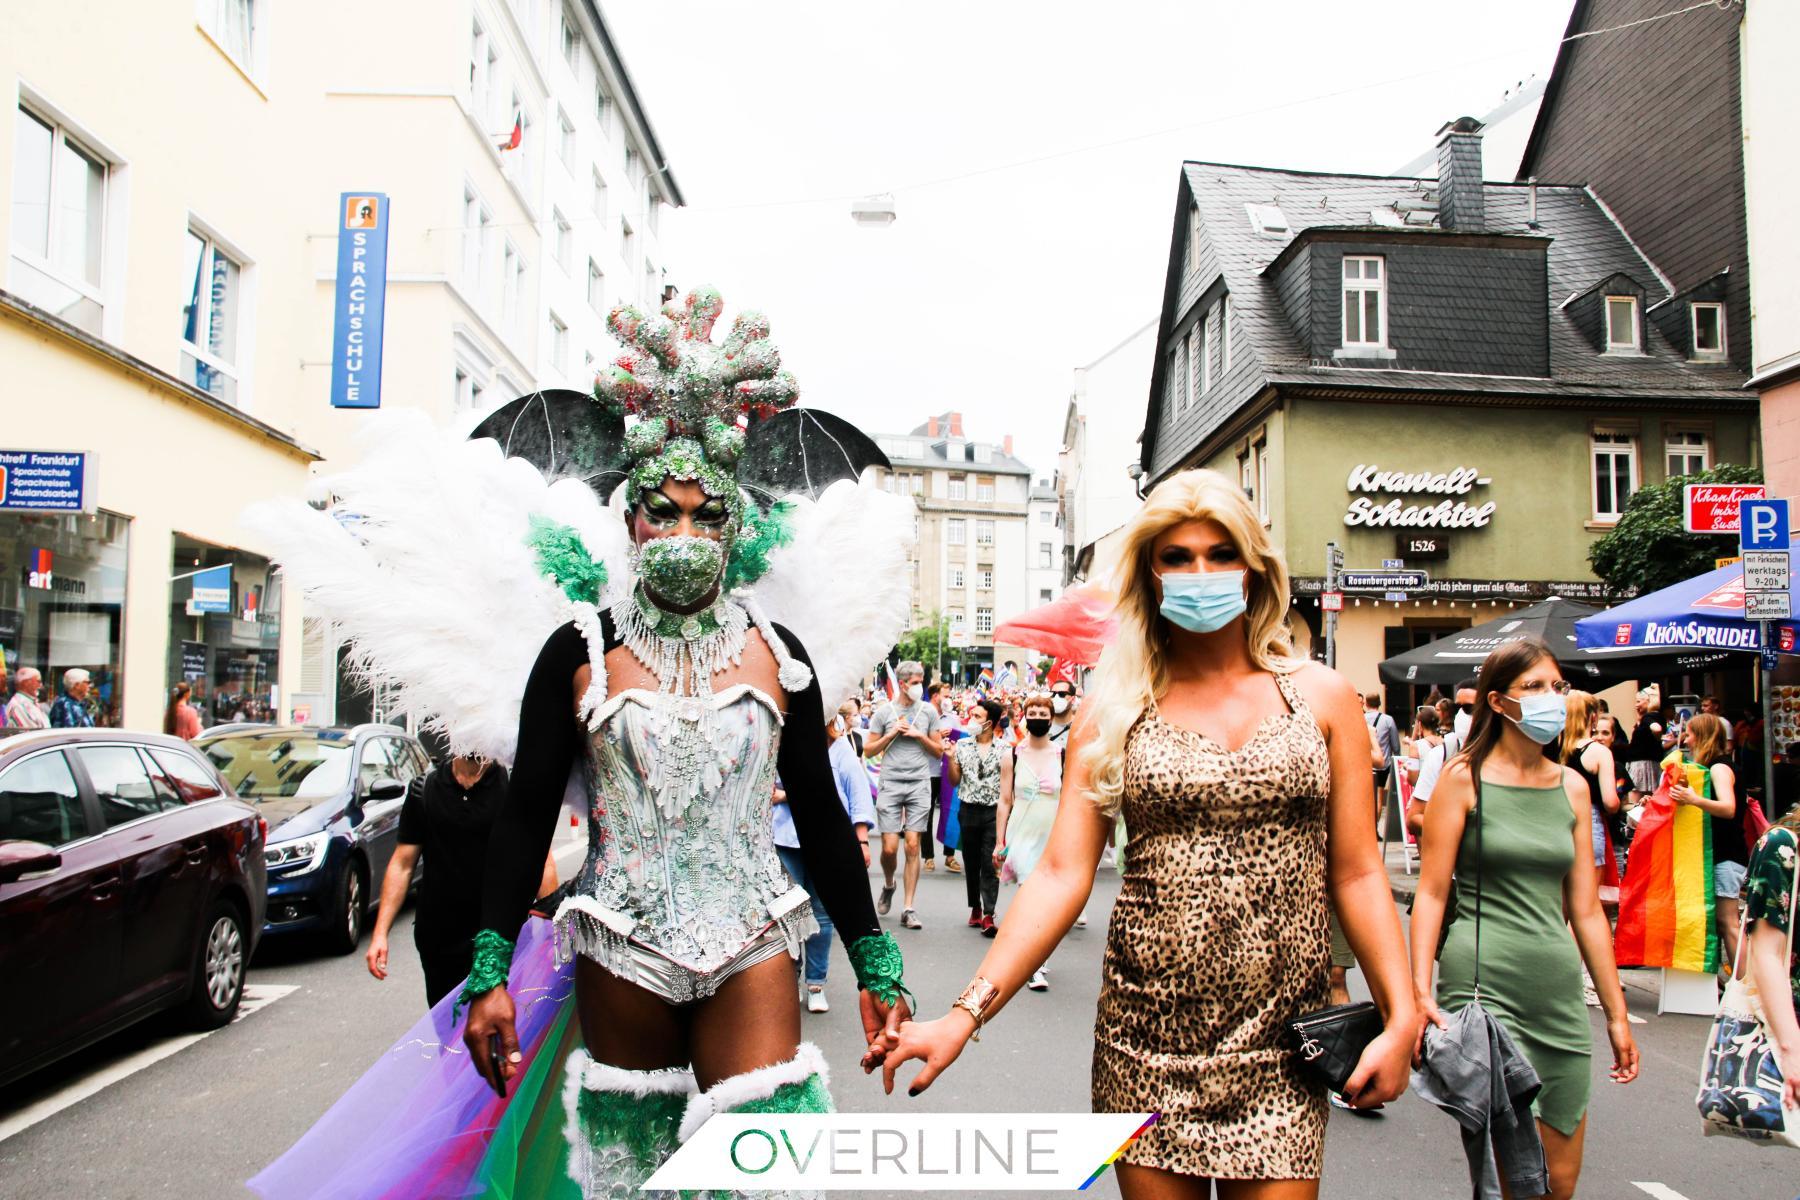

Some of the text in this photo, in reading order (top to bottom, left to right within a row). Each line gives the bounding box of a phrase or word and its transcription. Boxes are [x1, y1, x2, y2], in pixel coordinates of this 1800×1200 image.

[346, 232, 367, 401] SPRACHSCHULE
[0, 453, 80, 466] htreff Frankfurt
[1347, 464, 1493, 495] Krawall-
[1343, 497, 1496, 528] Schachtel
[1710, 503, 1740, 517] Imbis
[1711, 517, 1740, 530] Sush
[1410, 540, 1436, 552] 1526
[1757, 556, 1787, 564] Parkschein
[1747, 567, 1787, 576] werktags
[1348, 576, 1419, 587] Rosenbergerstraße
[1451, 581, 1472, 592] jeden
[1492, 582, 1504, 590] als
